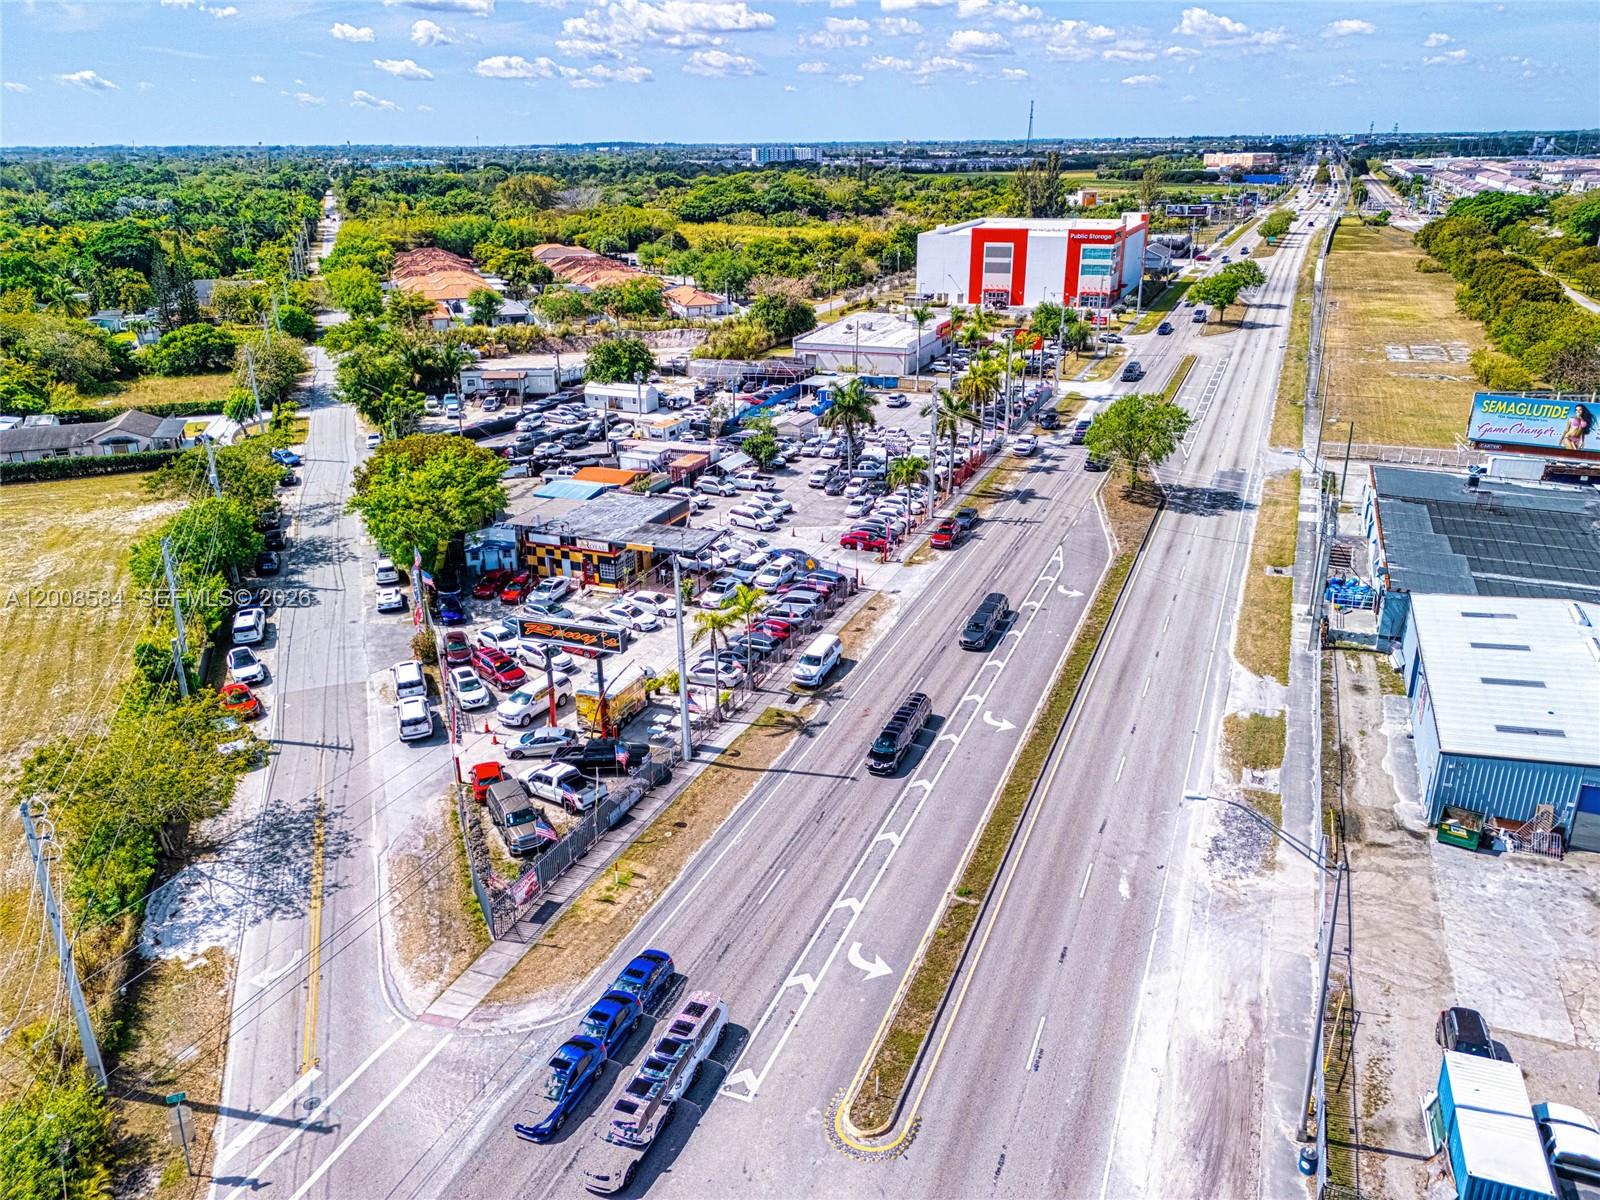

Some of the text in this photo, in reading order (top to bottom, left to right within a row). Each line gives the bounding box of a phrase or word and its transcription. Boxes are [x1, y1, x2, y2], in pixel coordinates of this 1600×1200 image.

[1089, 233, 1113, 241] Storage
[1481, 399, 1570, 419] SEMAGLUTIDE
[1477, 422, 1508, 438] Game
